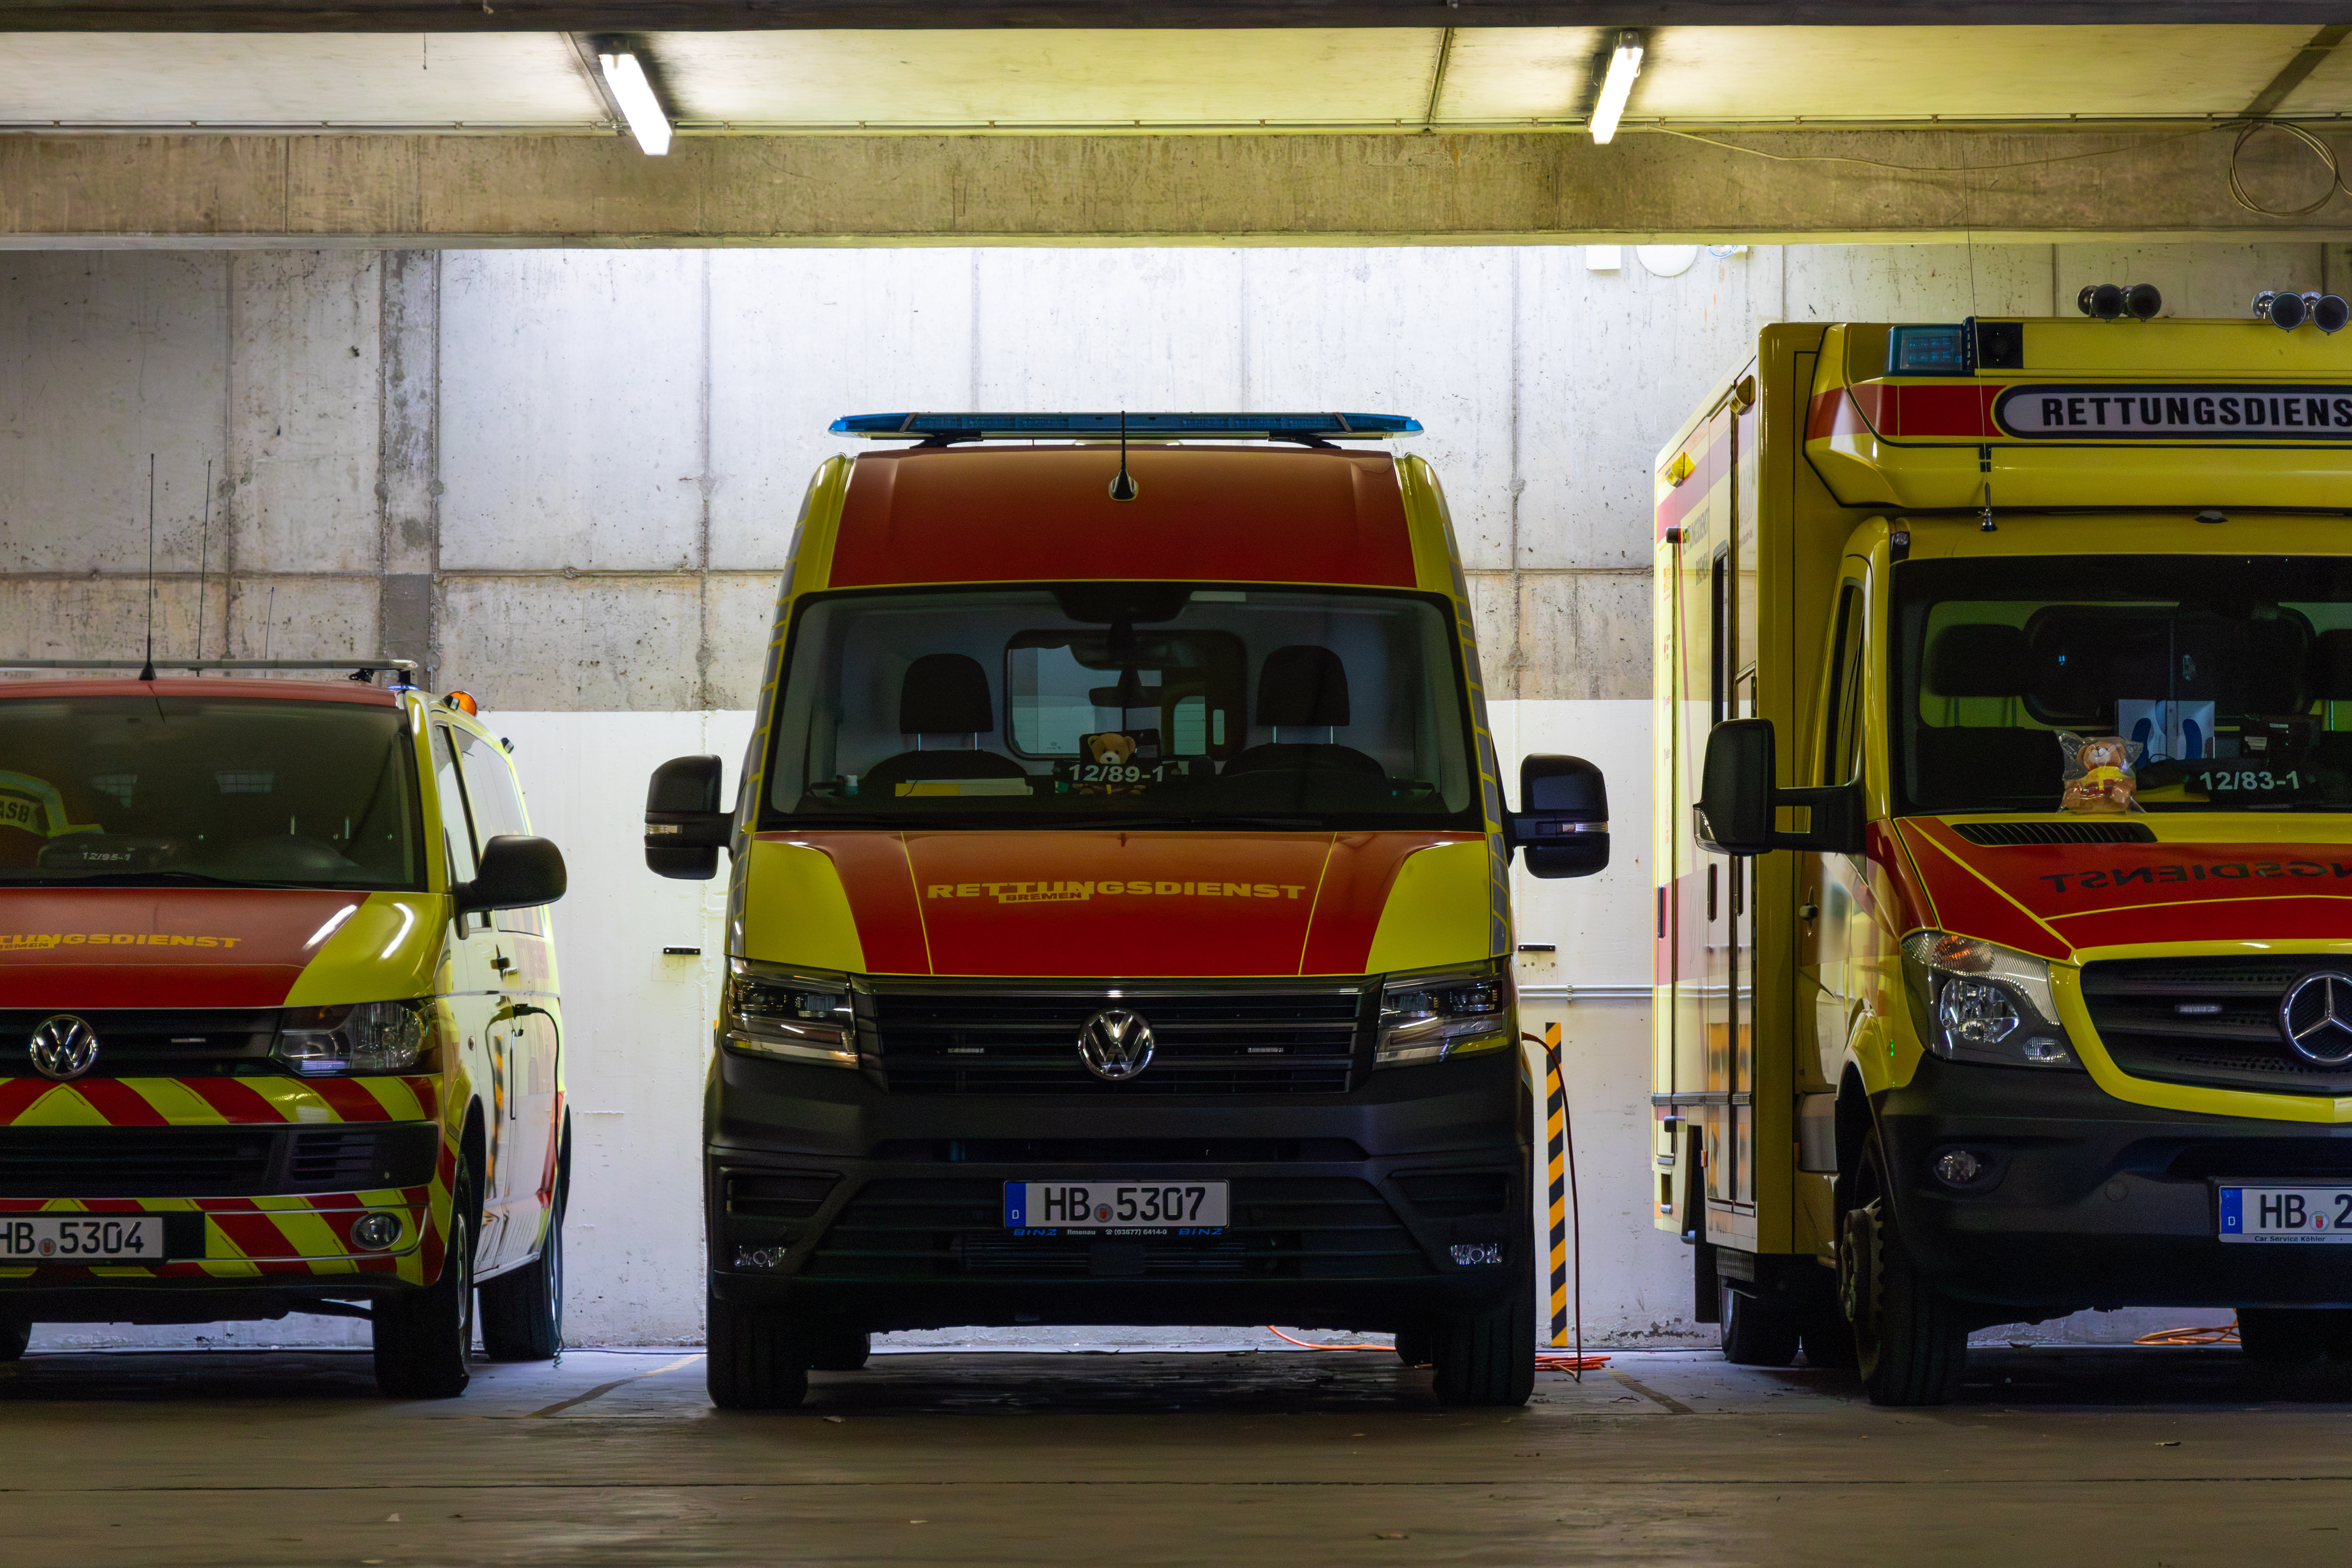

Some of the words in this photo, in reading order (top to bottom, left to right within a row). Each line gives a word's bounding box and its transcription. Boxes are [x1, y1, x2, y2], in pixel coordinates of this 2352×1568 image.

[2042, 397, 2352, 427] RETTUNGSDIENS
[1069, 764, 1163, 782] 12/89-1
[2199, 771, 2300, 790] 12/83-1
[927, 881, 1306, 899] RETTUNGSDIENST
[1006, 892, 1082, 901] BREMEN
[1045, 1187, 1090, 1221] HB
[1116, 1187, 1206, 1221] 5307
[2260, 1195, 2307, 1228] HB
[1012, 1210, 1019, 1219] D
[2228, 1216, 2236, 1226] D
[60, 1221, 144, 1253] 5304
